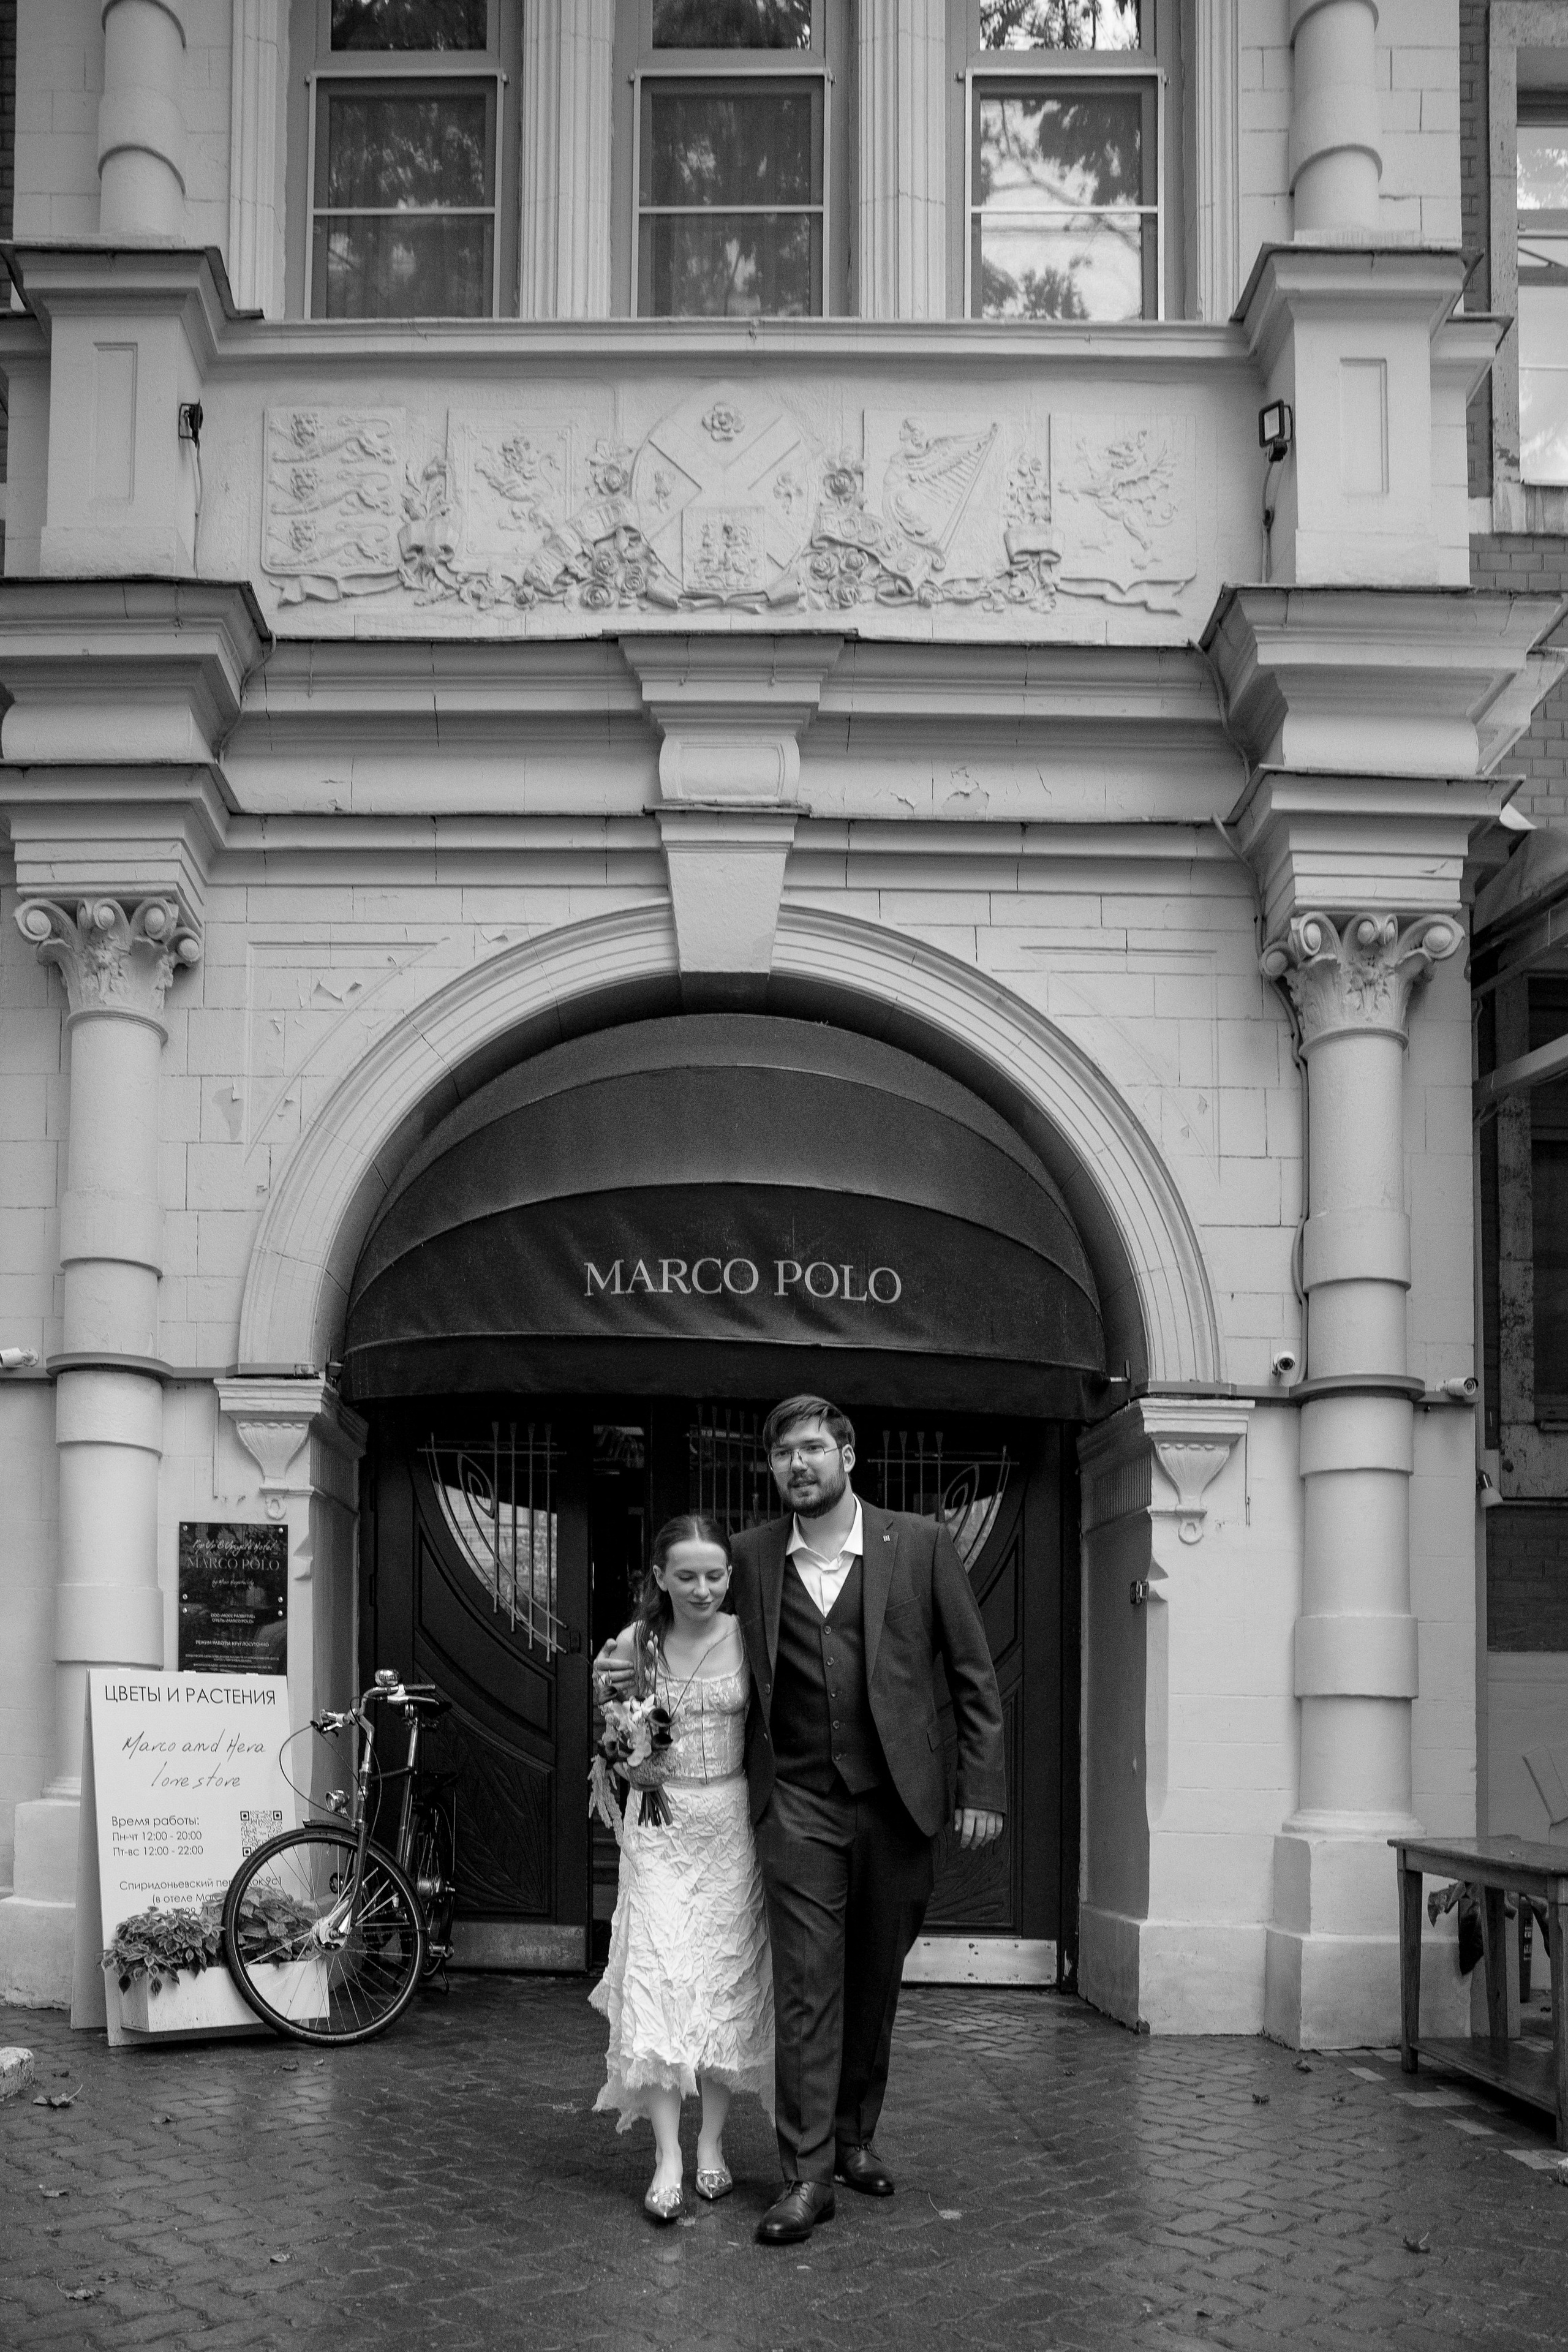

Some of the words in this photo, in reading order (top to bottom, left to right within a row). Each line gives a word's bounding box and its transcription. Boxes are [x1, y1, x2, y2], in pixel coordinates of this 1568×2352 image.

[584, 1257, 759, 1297] MARCO
[774, 1259, 902, 1304] POLO
[187, 1557, 238, 1569] MARCO
[243, 1558, 279, 1570] POLO
[105, 1685, 160, 1703] ЦВЕТЫ
[168, 1687, 179, 1702] И
[186, 1687, 276, 1705] РАСТЕНИЯ
[122, 1731, 177, 1759] Marco
[181, 1728, 225, 1752] and
[226, 1732, 266, 1762] Hera
[192, 1762, 241, 1789] store
[111, 1815, 150, 1828] Время
[153, 1815, 200, 1828] работы:
[112, 1831, 138, 1841] Пн-чт
[142, 1831, 168, 1841] 12:00
[176, 1830, 202, 1841] 20:00
[113, 1847, 140, 1856] Пт-вс
[144, 1846, 169, 1856] 12:00
[178, 1845, 203, 1855] 22:00
[119, 1878, 214, 1891] Спиридоньевский
[153, 1894, 160, 1905] (в
[164, 1894, 193, 1904] отеле
